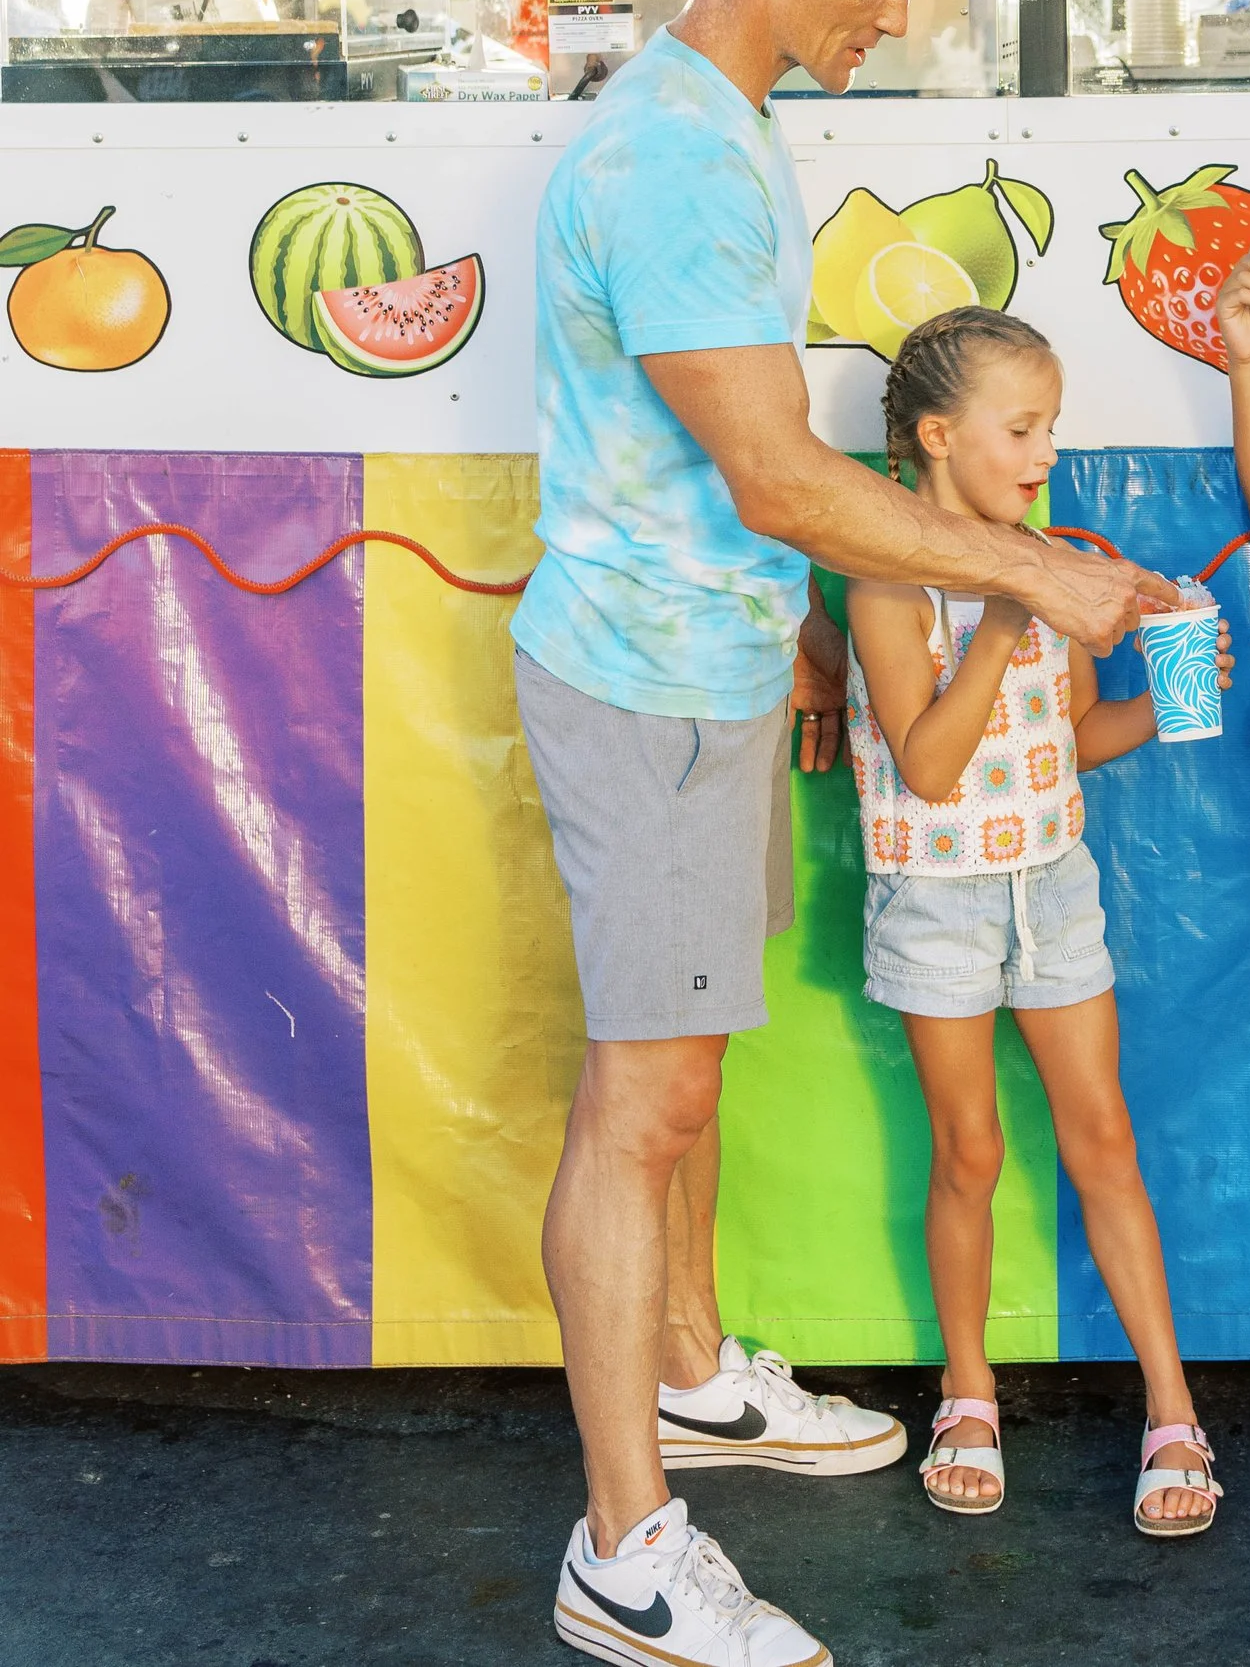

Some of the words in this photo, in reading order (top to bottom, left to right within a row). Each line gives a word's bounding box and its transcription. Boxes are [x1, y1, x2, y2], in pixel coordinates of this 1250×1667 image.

[577, 5, 599, 14] PYY
[458, 91, 478, 101] Dry
[481, 91, 505, 101] Wax
[509, 91, 541, 101] Paper
[645, 1520, 662, 1538] NIKE
